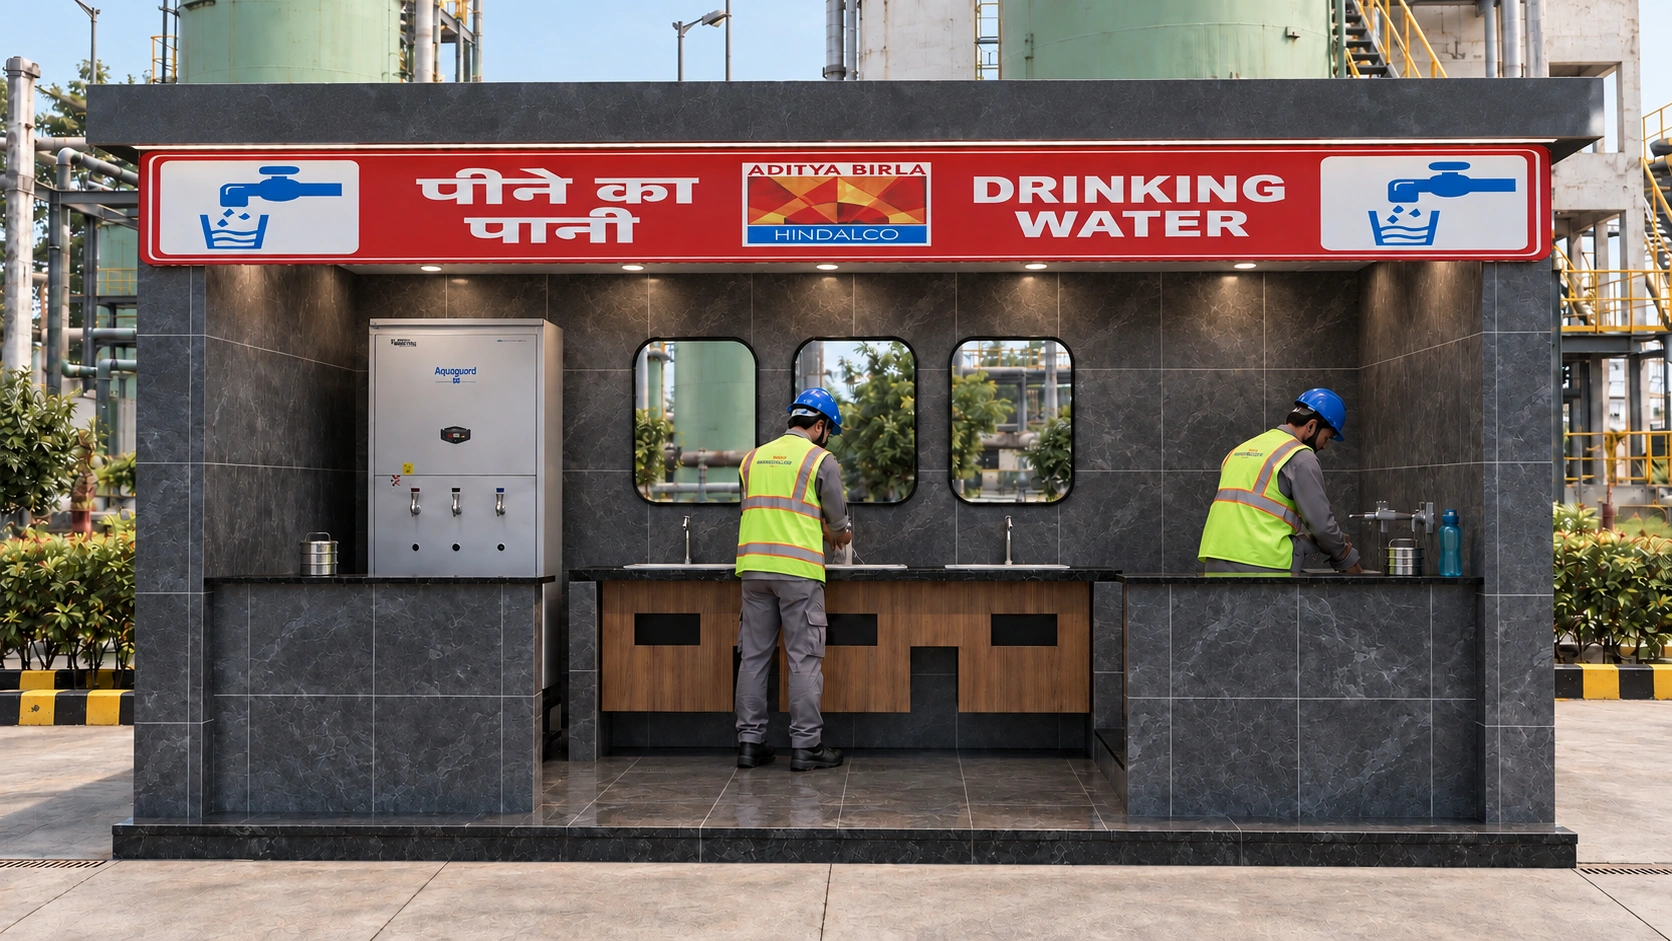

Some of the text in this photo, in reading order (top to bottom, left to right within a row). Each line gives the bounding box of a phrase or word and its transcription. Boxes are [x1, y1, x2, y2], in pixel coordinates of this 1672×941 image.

[748, 164, 926, 175] ADITYA BIRLA
[416, 167, 699, 205] पीने का
[973, 174, 1286, 203] DRINKING
[463, 206, 640, 243] पानी
[775, 229, 899, 241] HINDALCO
[1014, 210, 1249, 238] WATER
